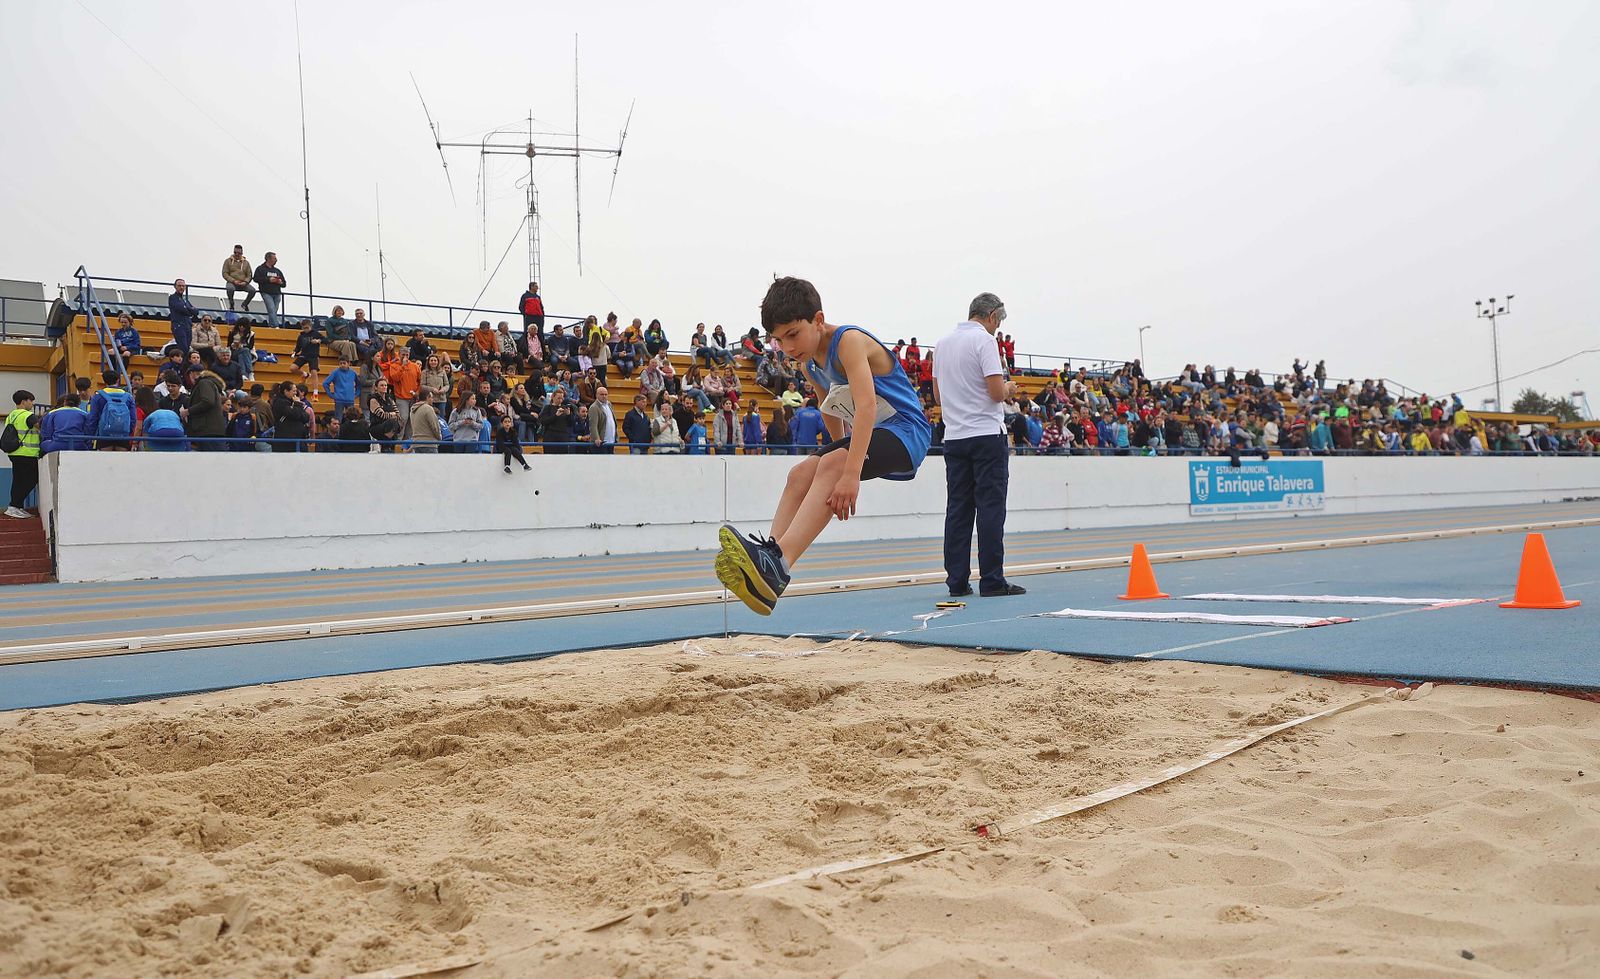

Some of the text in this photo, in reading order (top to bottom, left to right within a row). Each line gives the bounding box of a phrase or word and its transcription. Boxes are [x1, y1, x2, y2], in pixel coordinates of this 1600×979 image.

[1215, 465, 1270, 474] ESTADIO MUNICIPAL
[1216, 474, 1314, 496] Enrique Talavera
